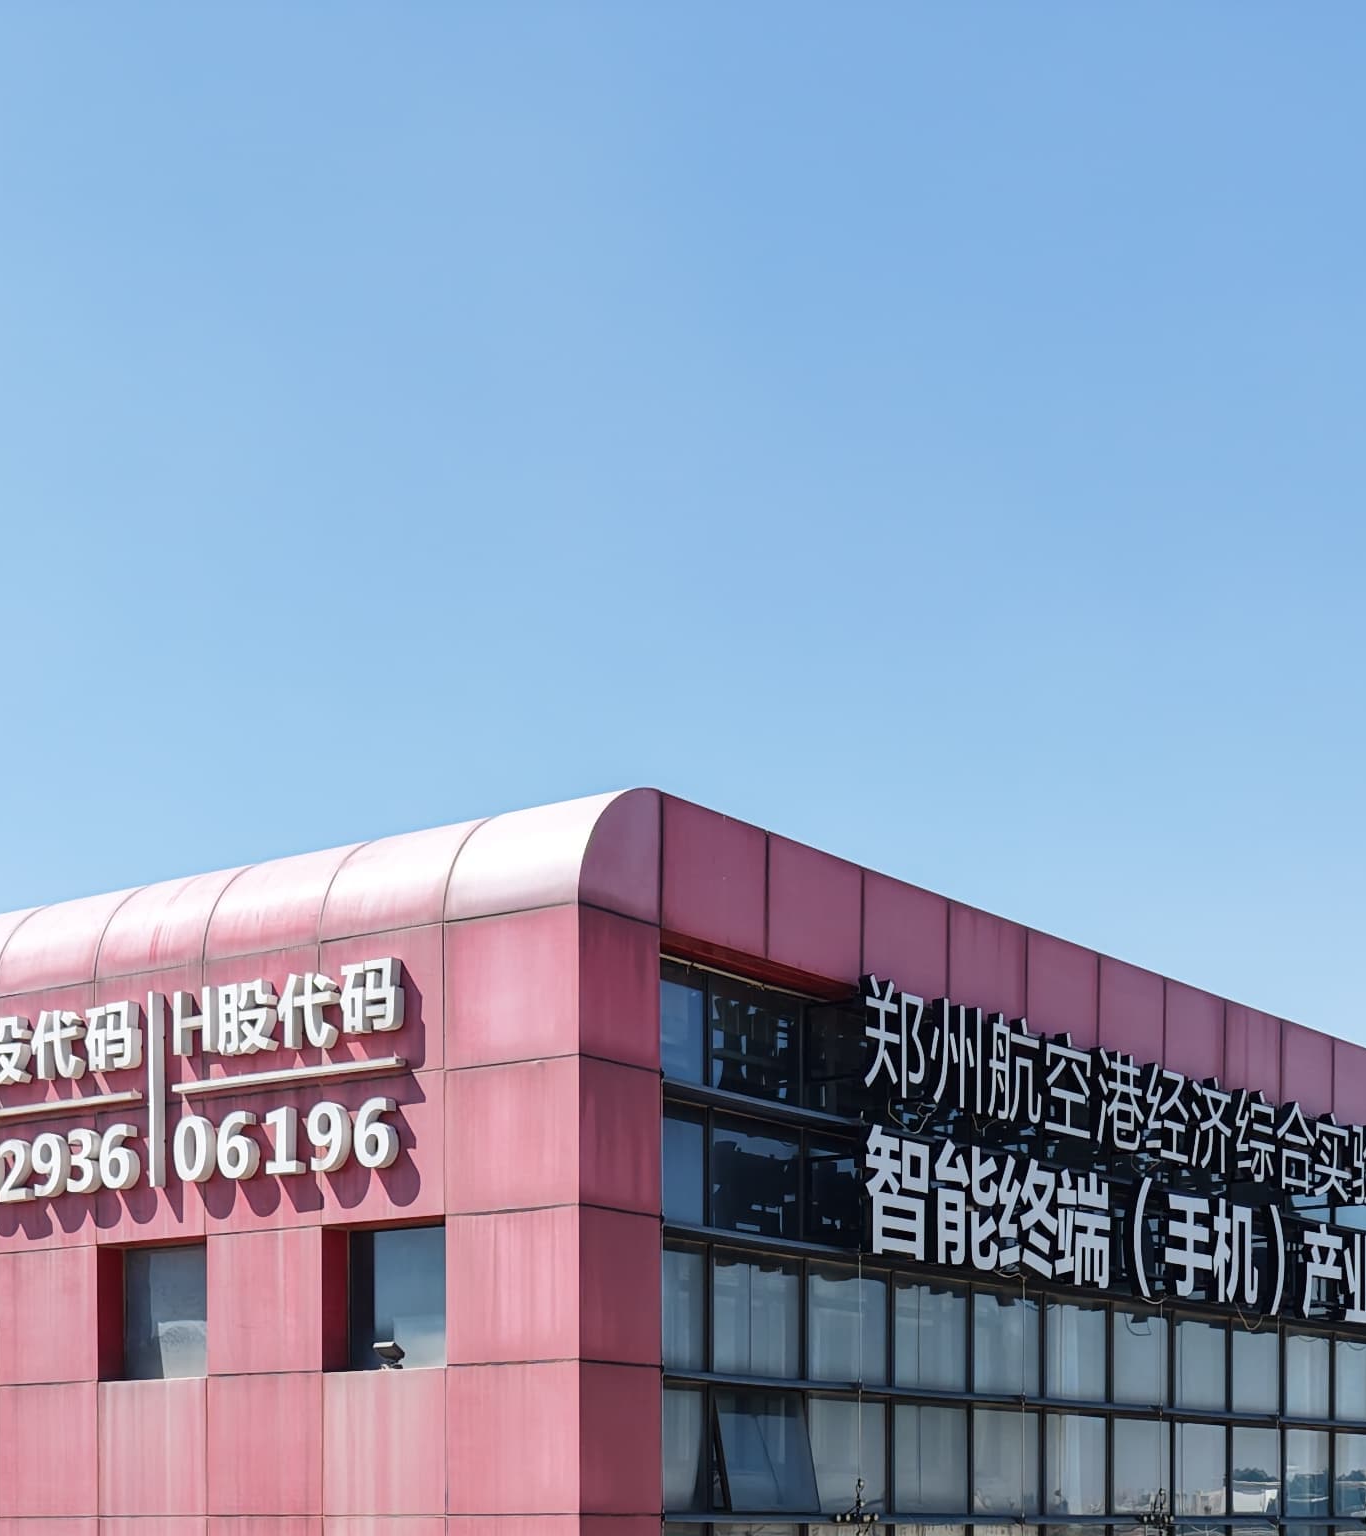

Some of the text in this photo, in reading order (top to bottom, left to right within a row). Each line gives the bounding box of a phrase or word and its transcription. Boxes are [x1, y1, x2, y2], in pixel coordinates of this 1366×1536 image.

[173, 957, 405, 1057] H股代码
[172, 1097, 400, 1182] 06196
